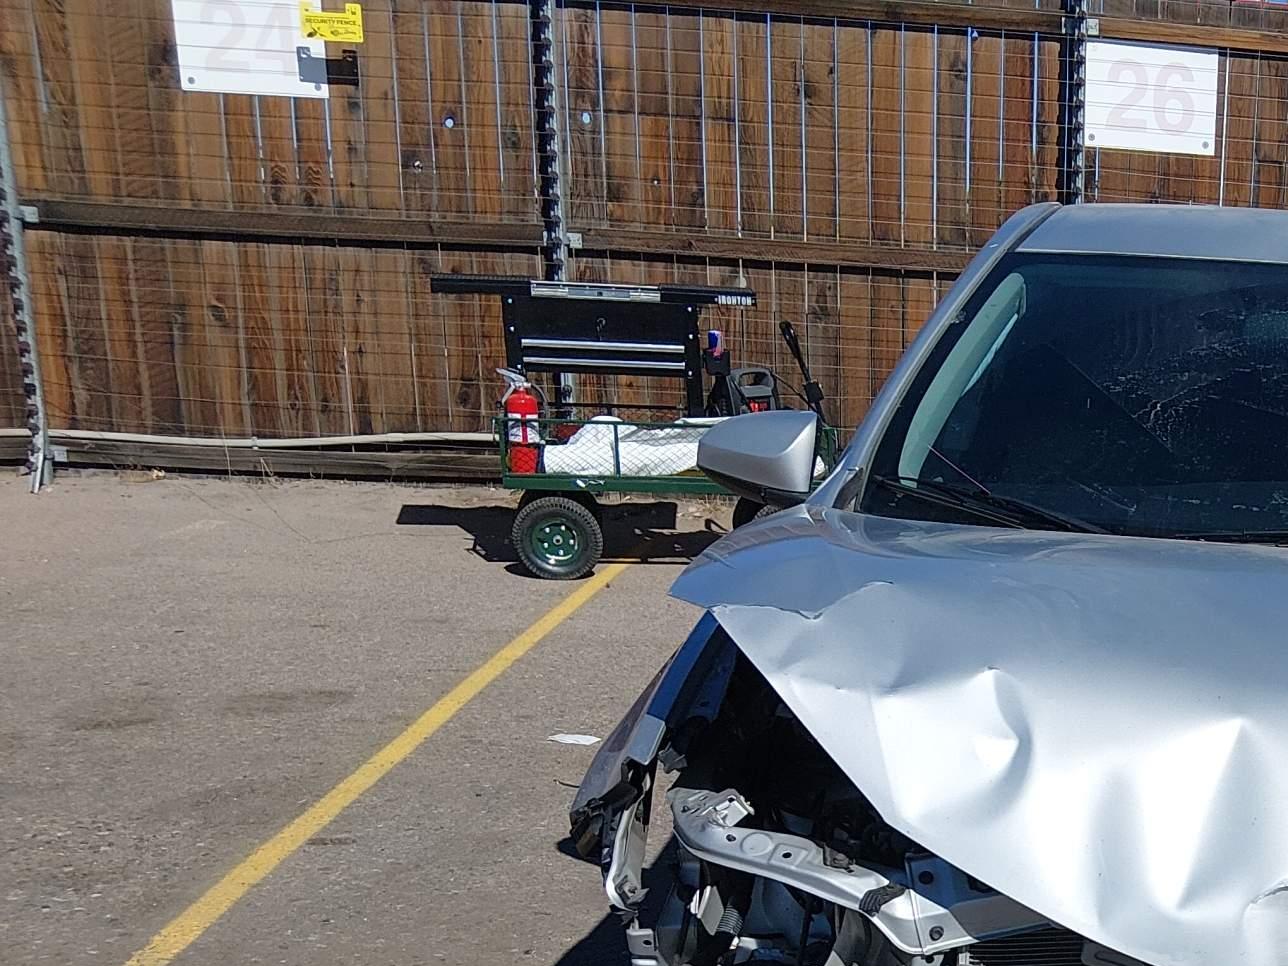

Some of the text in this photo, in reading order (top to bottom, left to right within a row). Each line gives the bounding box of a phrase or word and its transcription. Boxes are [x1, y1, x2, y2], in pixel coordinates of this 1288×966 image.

[201, 0, 293, 75] 24
[304, 17, 335, 25] SECURITY
[1105, 58, 1195, 135] 26
